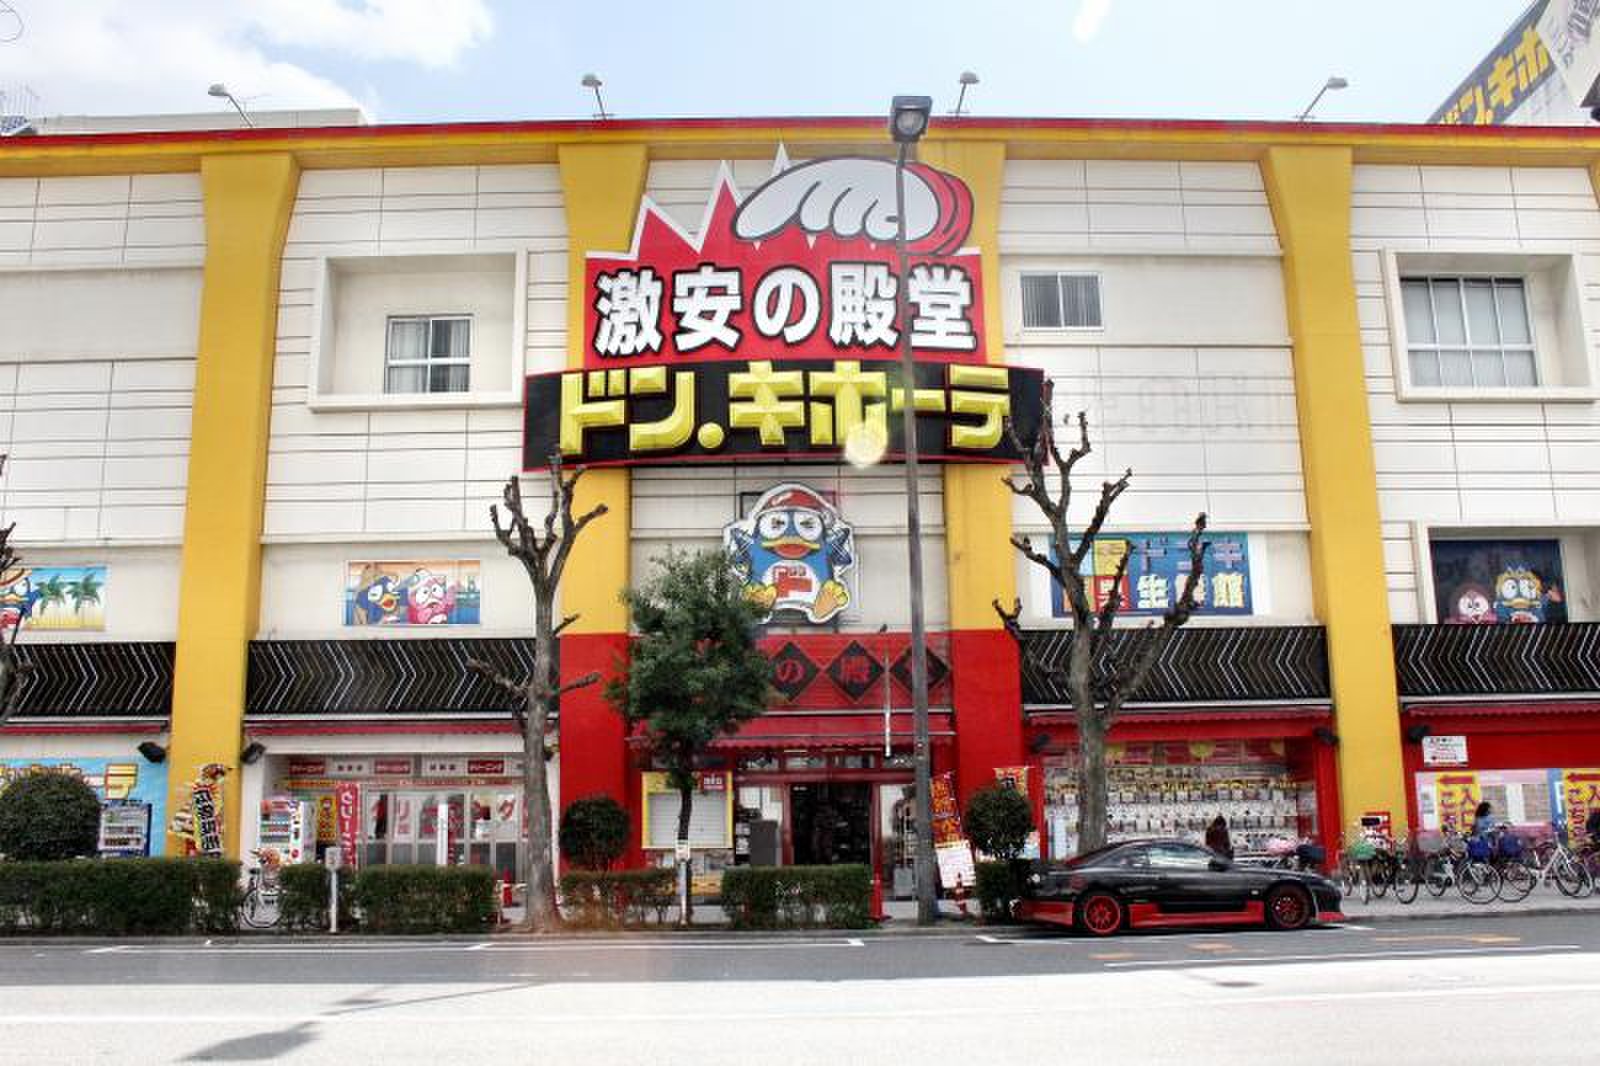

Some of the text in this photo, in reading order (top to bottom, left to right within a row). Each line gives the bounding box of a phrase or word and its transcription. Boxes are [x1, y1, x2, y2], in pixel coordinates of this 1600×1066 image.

[596, 264, 976, 355] 激安の殿堂
